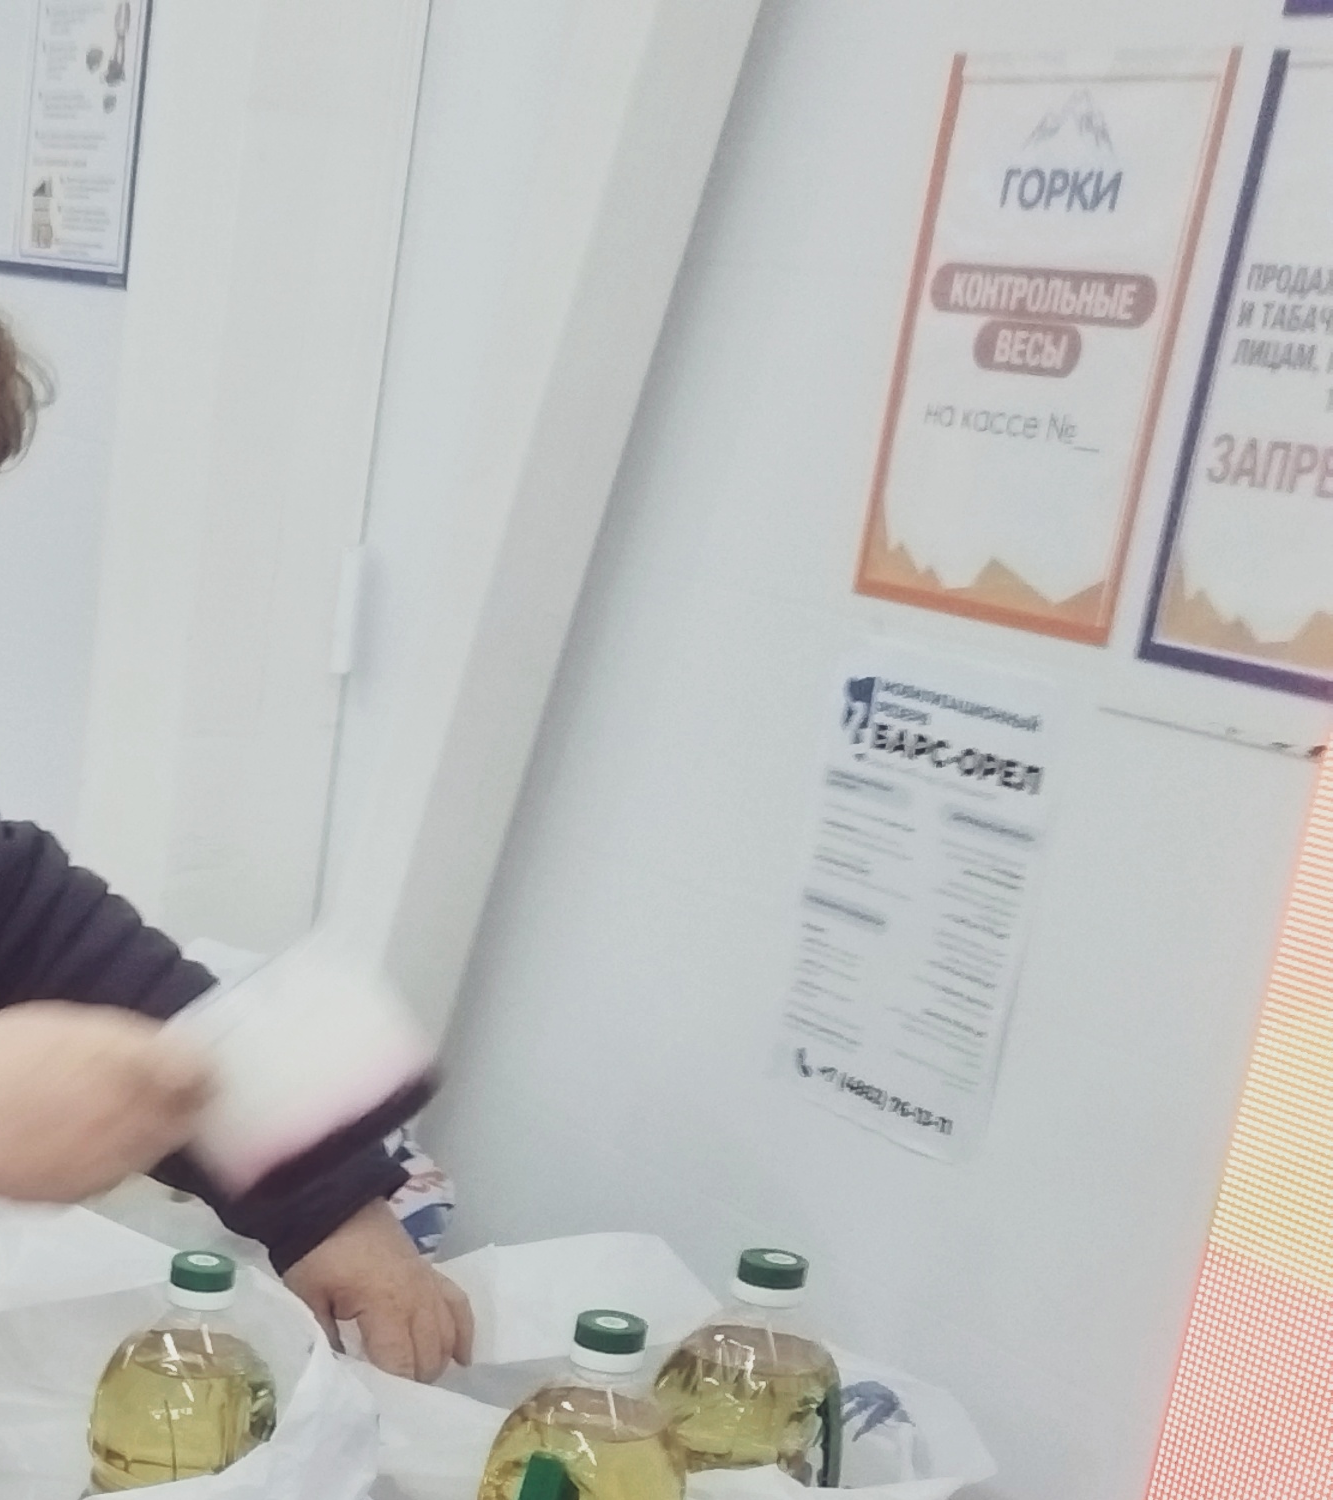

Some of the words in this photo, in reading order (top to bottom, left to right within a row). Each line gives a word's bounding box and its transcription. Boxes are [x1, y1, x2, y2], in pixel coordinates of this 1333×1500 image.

[1000, 168, 1123, 212] ГОРКИ
[949, 272, 1136, 320] КОНТРОЛЬНЫЕ
[994, 330, 1068, 369] ВЕСЫ
[924, 403, 955, 428] на
[960, 409, 1039, 440] кассе
